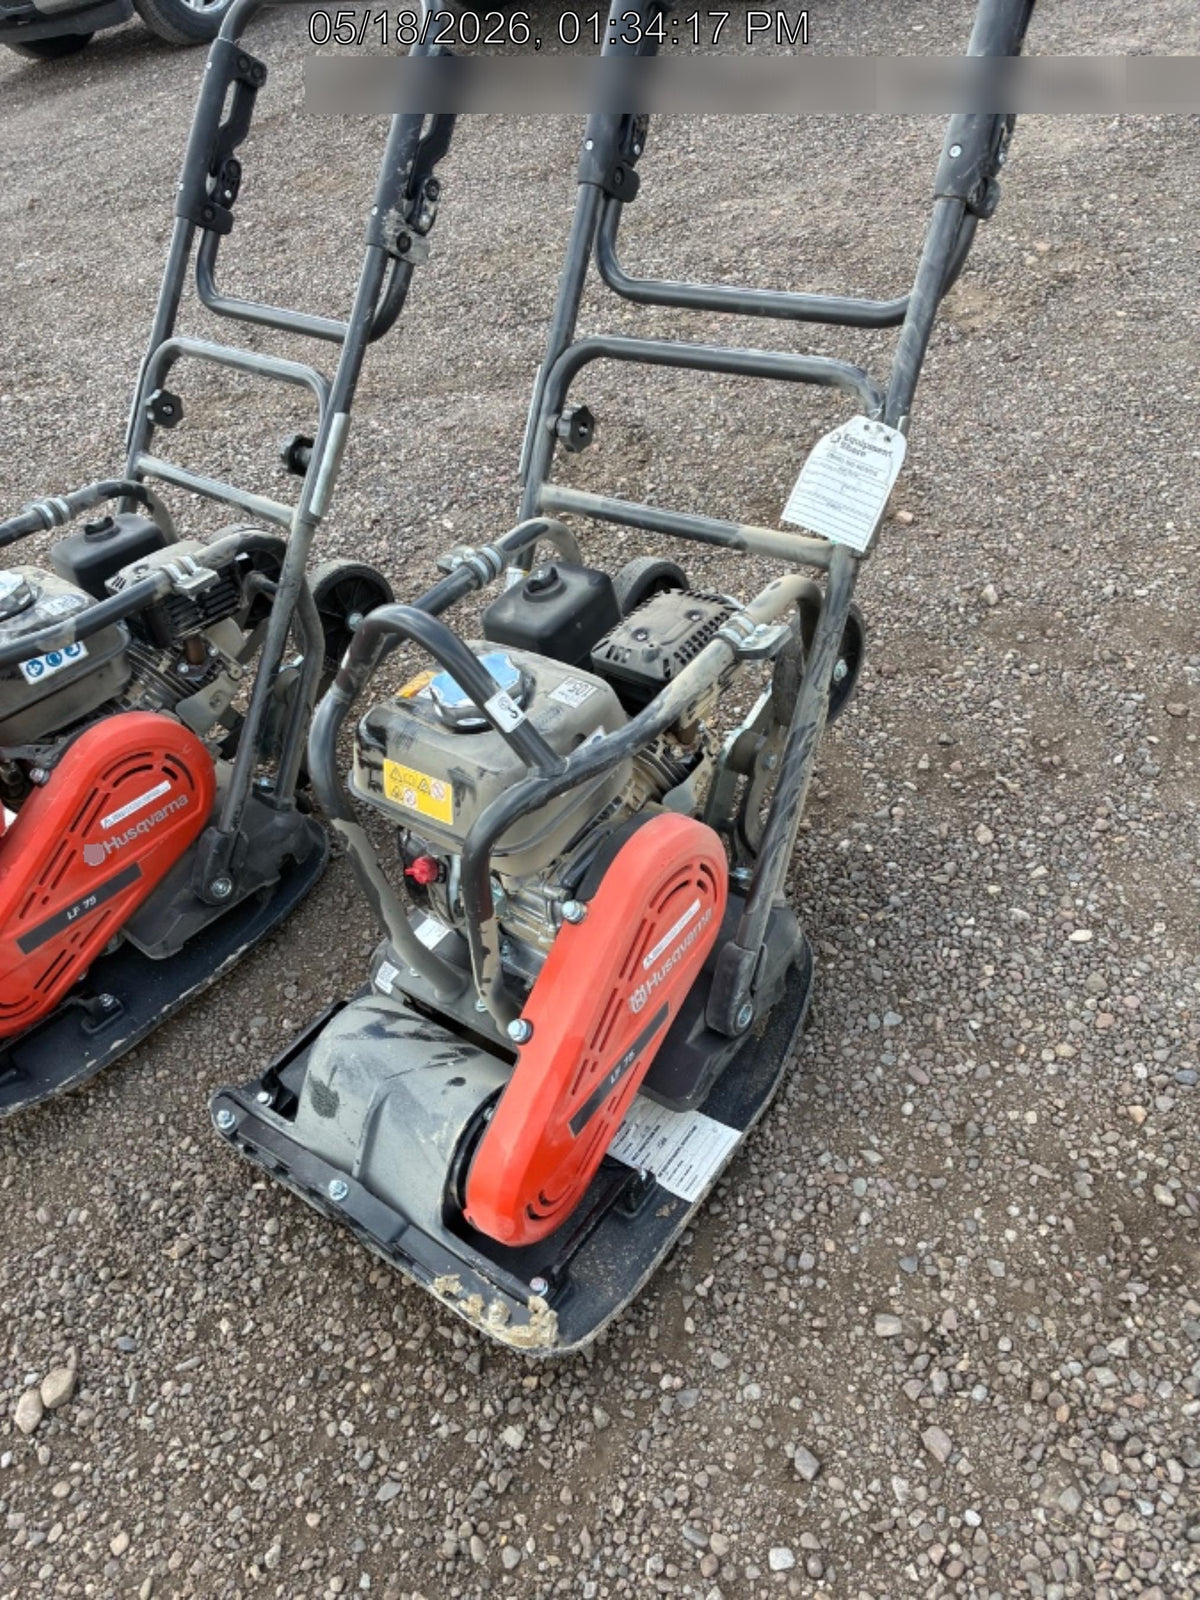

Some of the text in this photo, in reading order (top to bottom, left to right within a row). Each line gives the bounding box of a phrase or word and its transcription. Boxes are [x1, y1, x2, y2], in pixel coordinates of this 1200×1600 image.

[844, 432, 894, 458] Equipment
[103, 794, 189, 855] Husqvarna
[66, 895, 97, 920] LF 75
[646, 907, 713, 995] Husqvarna
[609, 1050, 637, 1085] LF 75
